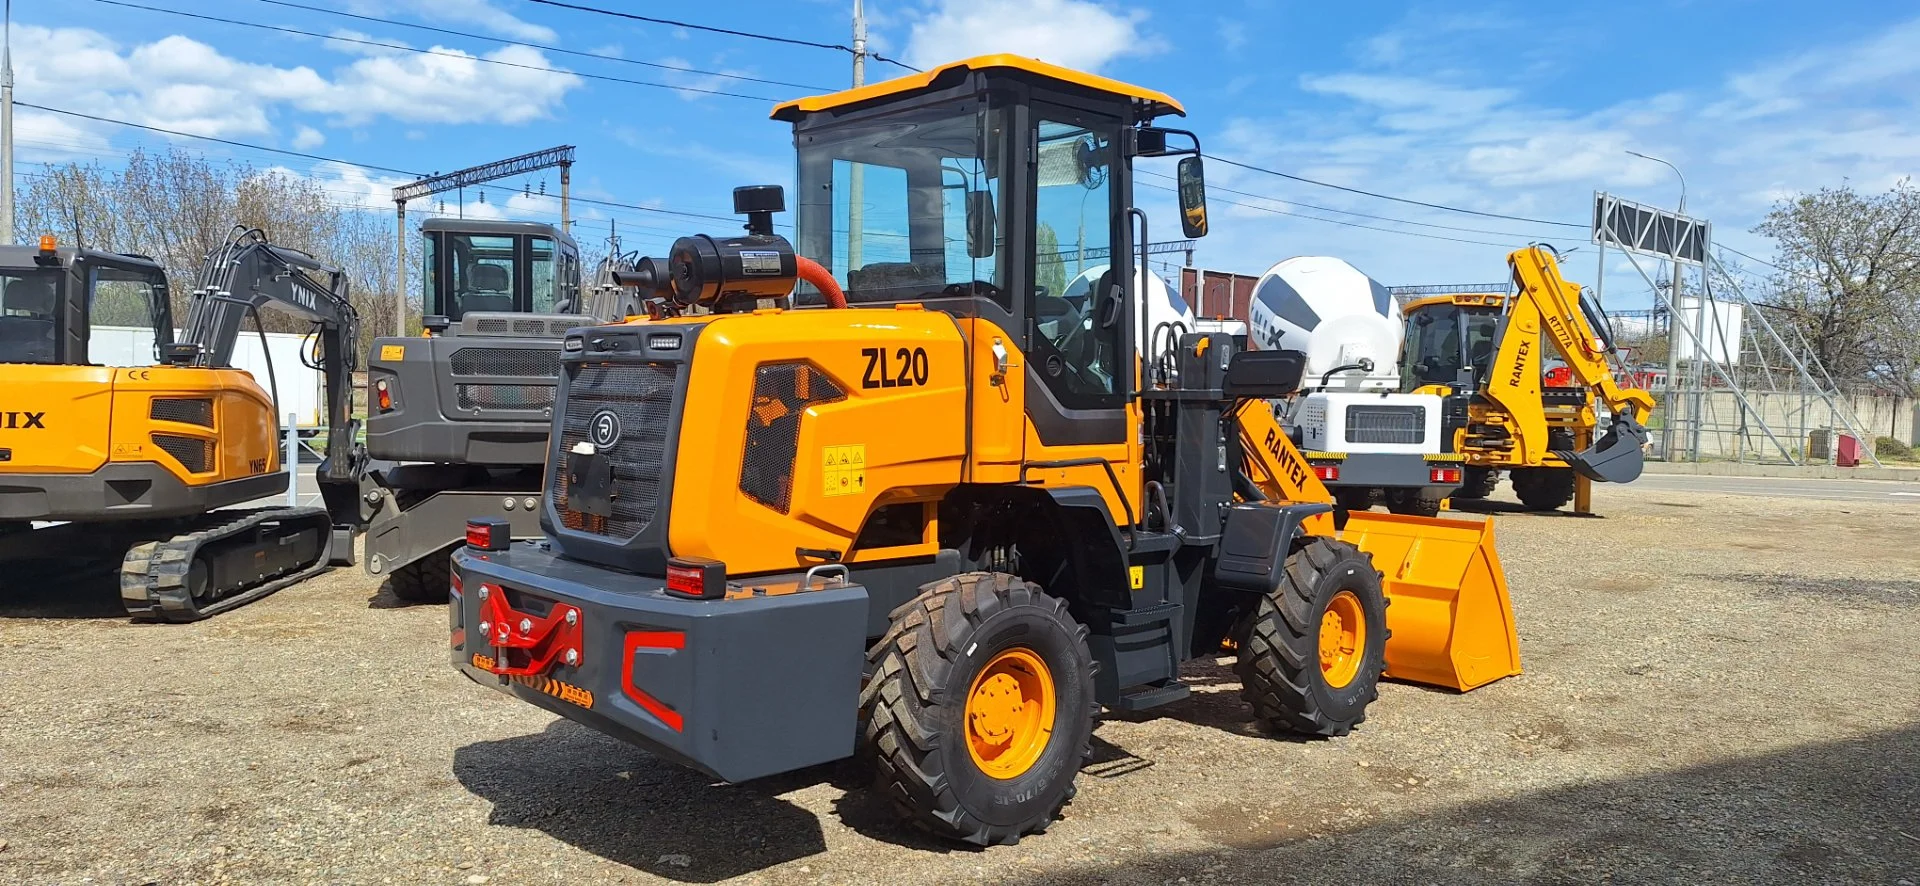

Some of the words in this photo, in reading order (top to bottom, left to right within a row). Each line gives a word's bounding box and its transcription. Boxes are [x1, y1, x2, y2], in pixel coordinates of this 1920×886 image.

[291, 281, 317, 311] YNIX
[1251, 306, 1286, 351] NIX
[1548, 315, 1573, 349] RT777A
[861, 346, 929, 389] ZL20
[1509, 339, 1531, 388] RANTEX
[0, 411, 46, 429] IX
[1264, 427, 1308, 493] RANTEX
